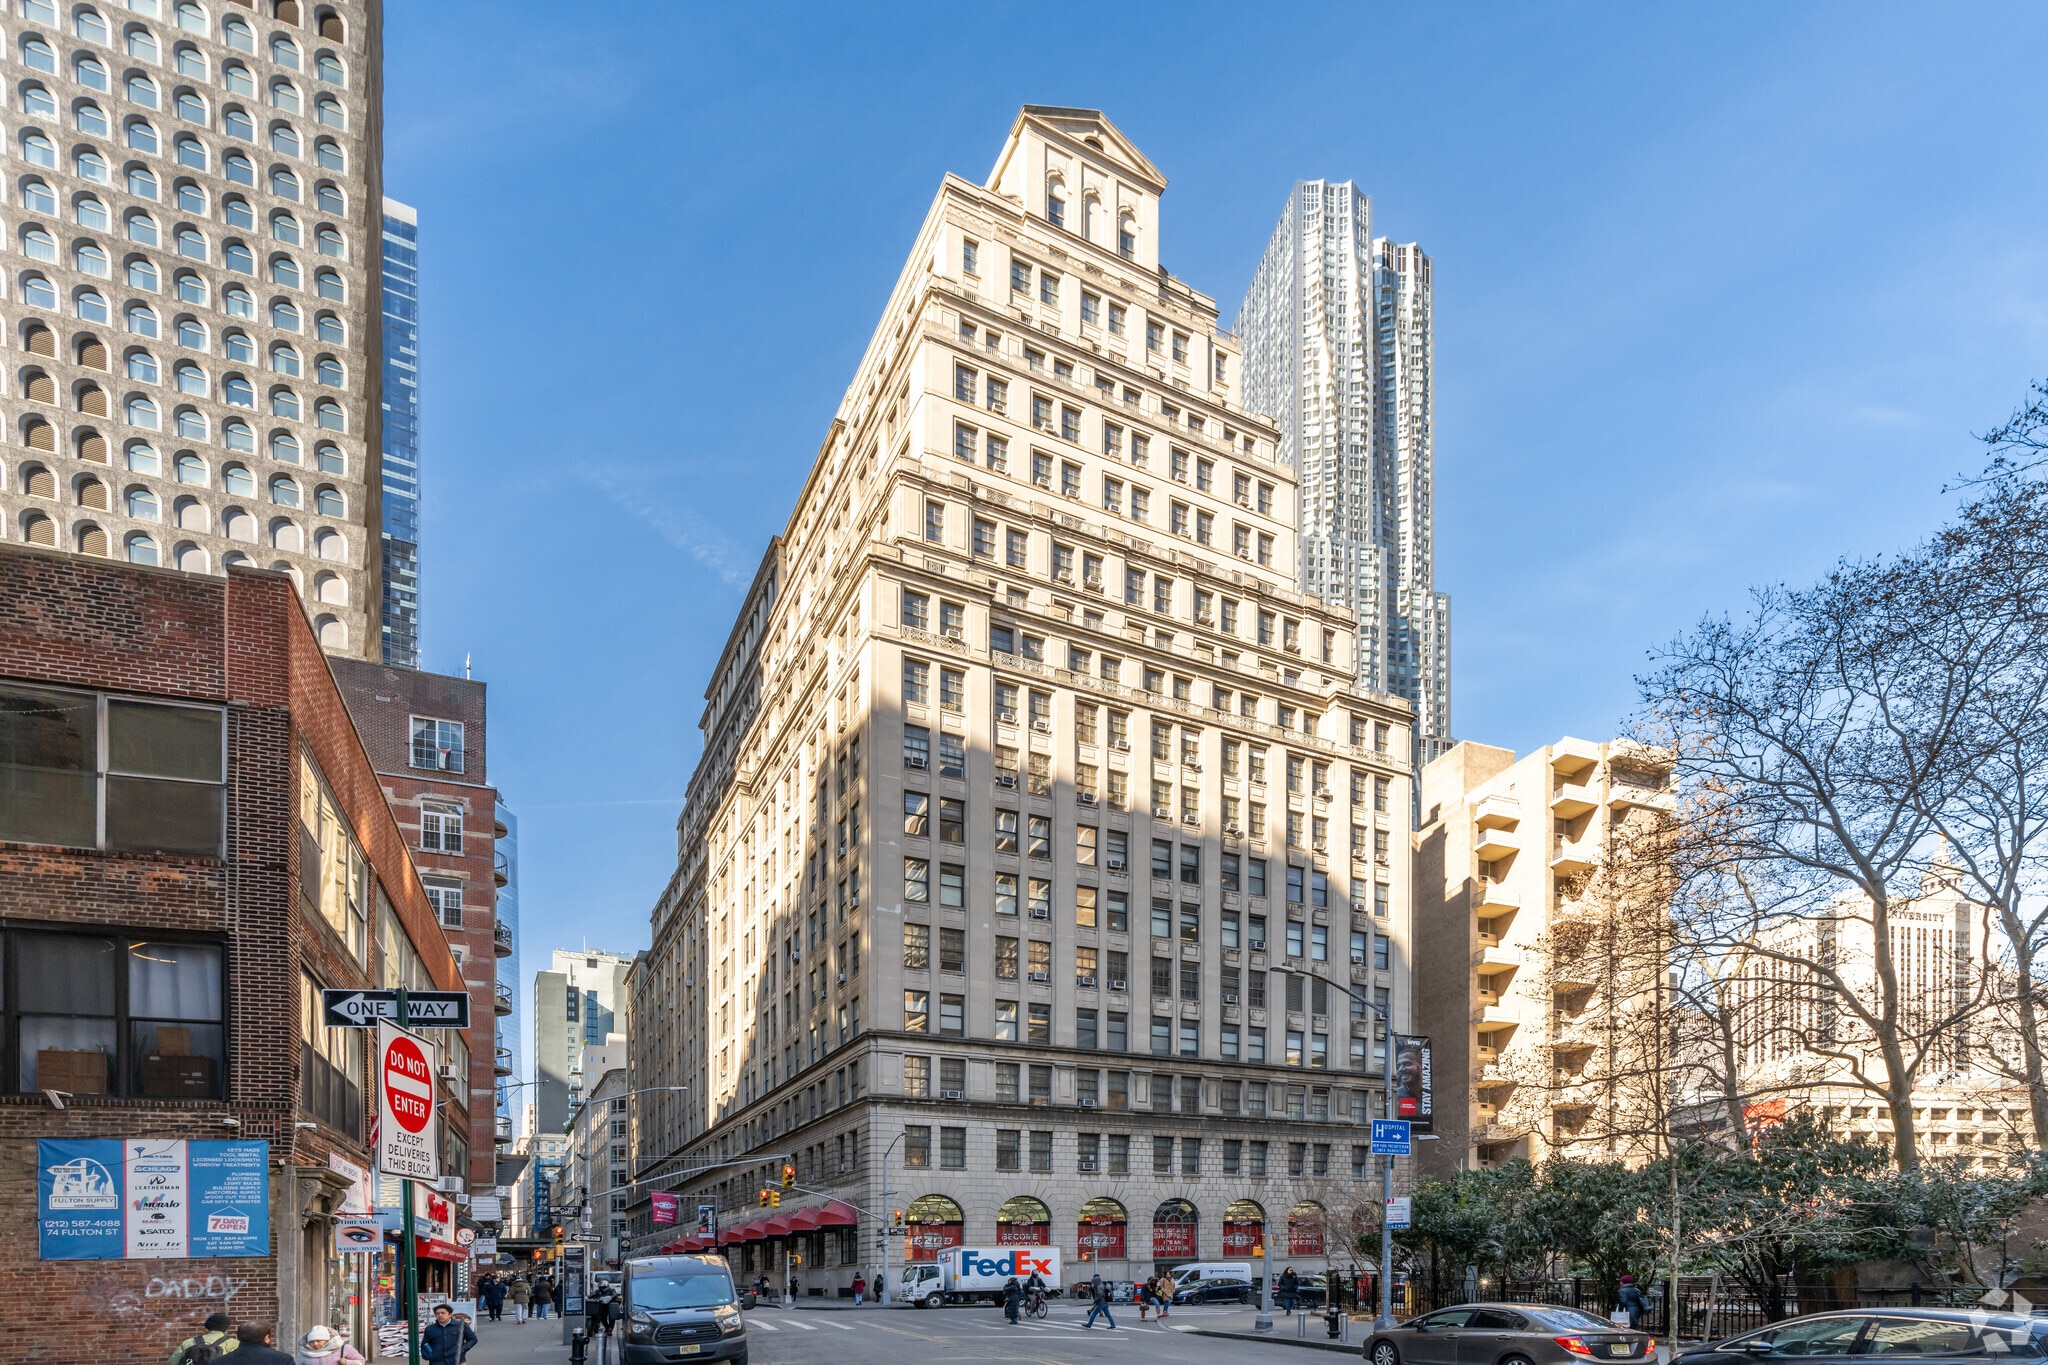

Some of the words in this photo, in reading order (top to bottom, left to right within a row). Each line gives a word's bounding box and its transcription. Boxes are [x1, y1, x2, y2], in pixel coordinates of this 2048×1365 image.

[1887, 911, 1945, 922] NIVERSITY
[347, 1002, 387, 1015] ONE
[407, 1003, 449, 1016] WAY
[390, 1050, 404, 1070] DO
[407, 1057, 425, 1078] NOT
[1421, 1048, 1431, 1090] AMAZING
[394, 1094, 425, 1118] ENTER
[1421, 1091, 1431, 1115] STAY
[397, 1132, 424, 1147] EXCEPT
[1376, 1124, 1405, 1138] HOSPITAL
[388, 1144, 430, 1162] DELIVERIES
[388, 1158, 406, 1171] THIS
[408, 1161, 431, 1175] BLOCK
[379, 1176, 400, 1208] DWARE
[45, 1220, 69, 1229] (212)
[210, 1218, 221, 1229] 7
[909, 1235, 953, 1245] LOT-LESS
[939, 1253, 952, 1264] FedEx
[962, 1251, 1052, 1276] FedEx
[144, 1275, 247, 1302] DADDY
